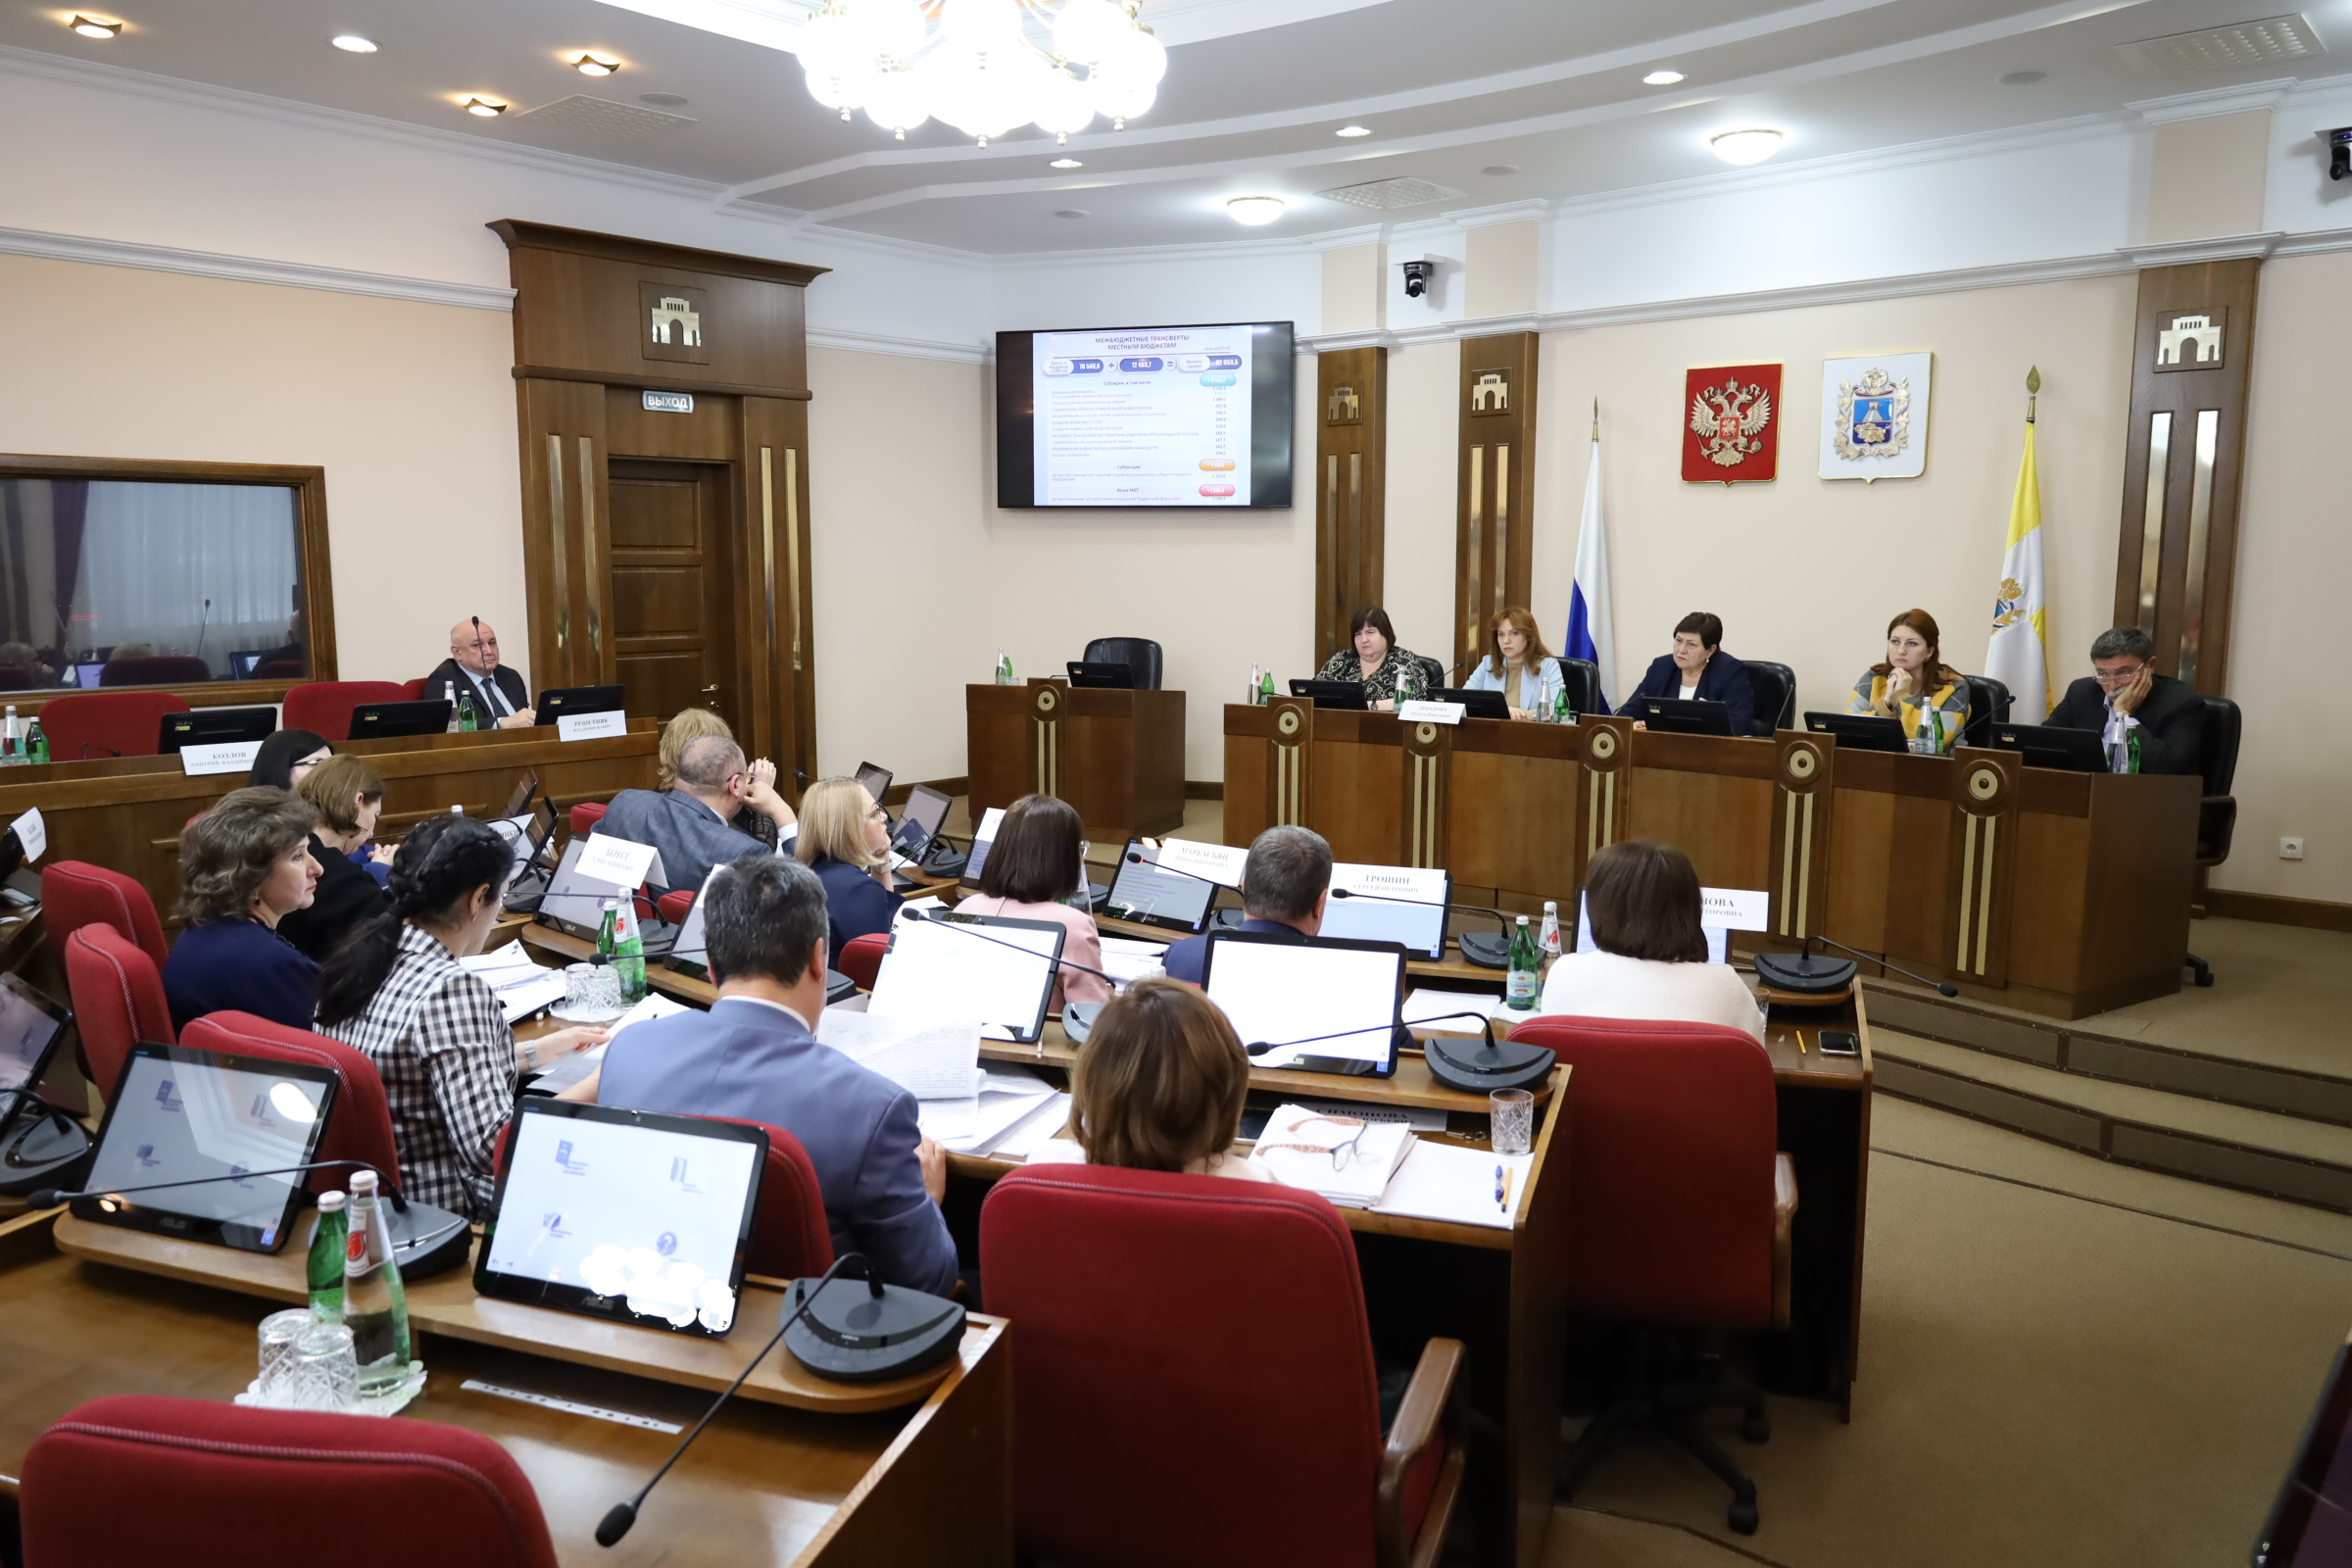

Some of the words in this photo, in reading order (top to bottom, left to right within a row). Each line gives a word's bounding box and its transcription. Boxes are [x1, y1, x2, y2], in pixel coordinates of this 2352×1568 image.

[1095, 336, 1149, 344] МЕЖБЮДЖЕТНЫЕ
[1150, 334, 1190, 343] ТРАНСФЕРТЫ
[648, 395, 688, 409] ВЫХОД
[574, 718, 609, 727] РЕШЕТНЯК
[606, 848, 630, 861] БЕРЕСТ
[1182, 847, 1228, 860] МАРКАСЬЯН
[1364, 874, 1410, 884] ТРОШИН
[1381, 885, 1418, 893] ПЕТРОВИЧ
[1703, 908, 1742, 917] ТОРОВНА
[1316, 1108, 1407, 1118] СИМОНОВА
